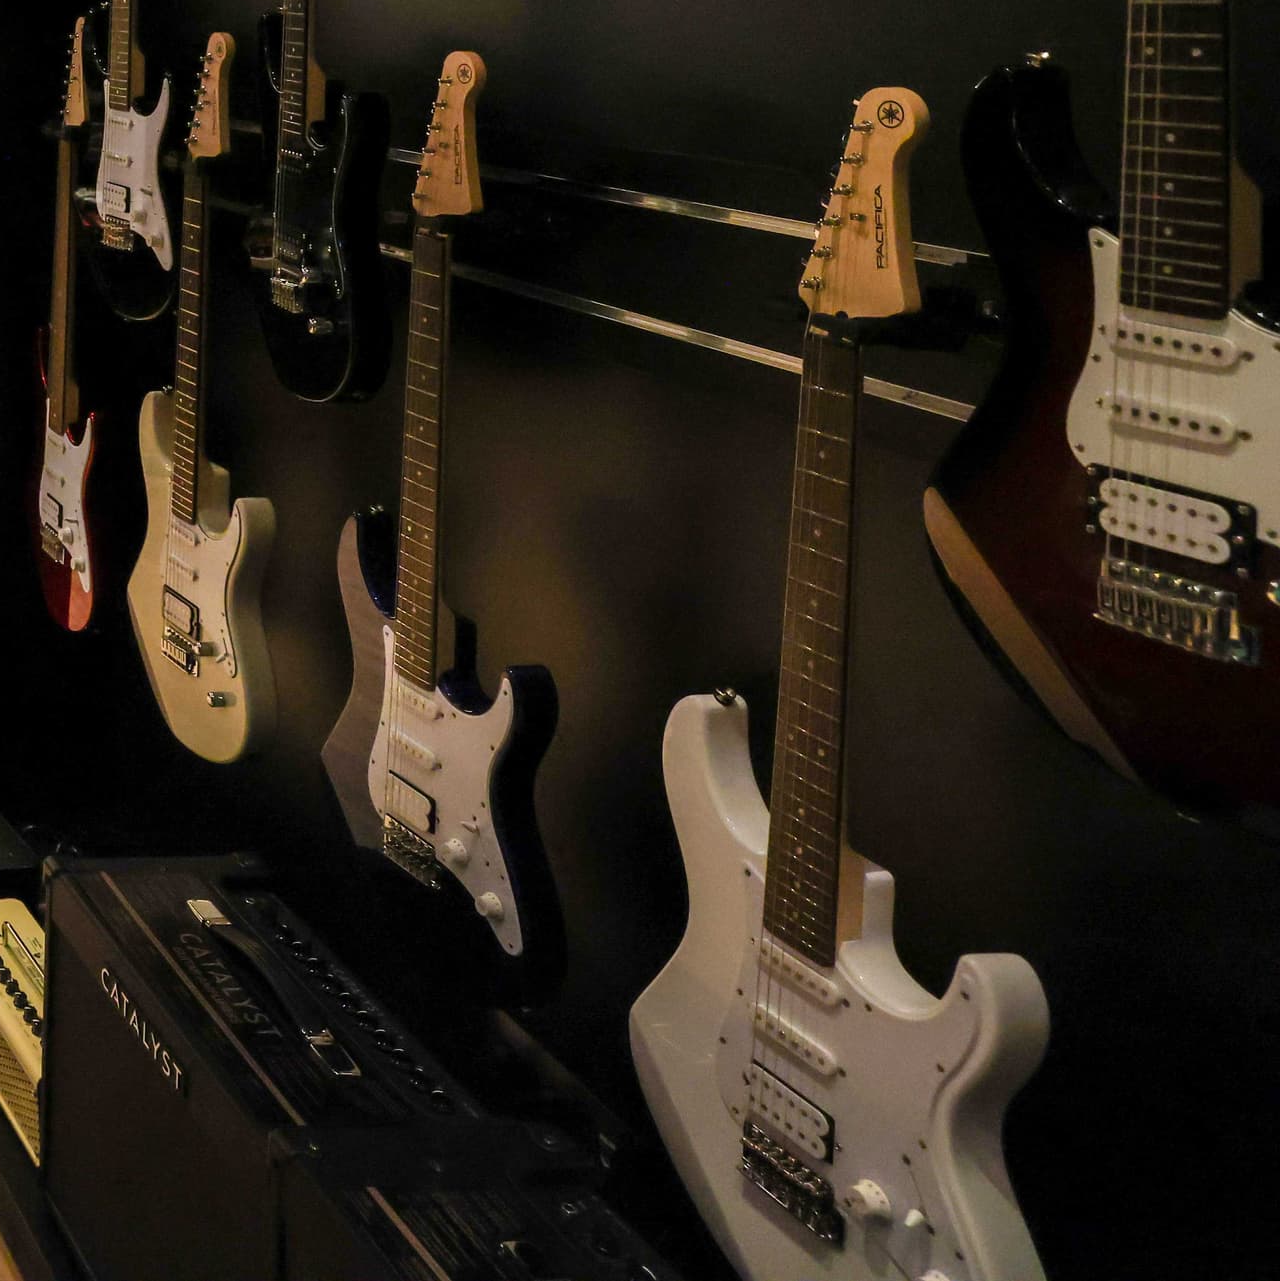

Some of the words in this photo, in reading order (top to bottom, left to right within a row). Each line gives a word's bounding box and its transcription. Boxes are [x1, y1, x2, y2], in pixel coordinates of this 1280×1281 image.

[874, 184, 885, 270] PACIFICA
[101, 968, 182, 1090] CATALYST
[179, 933, 284, 1038] CATALYST
